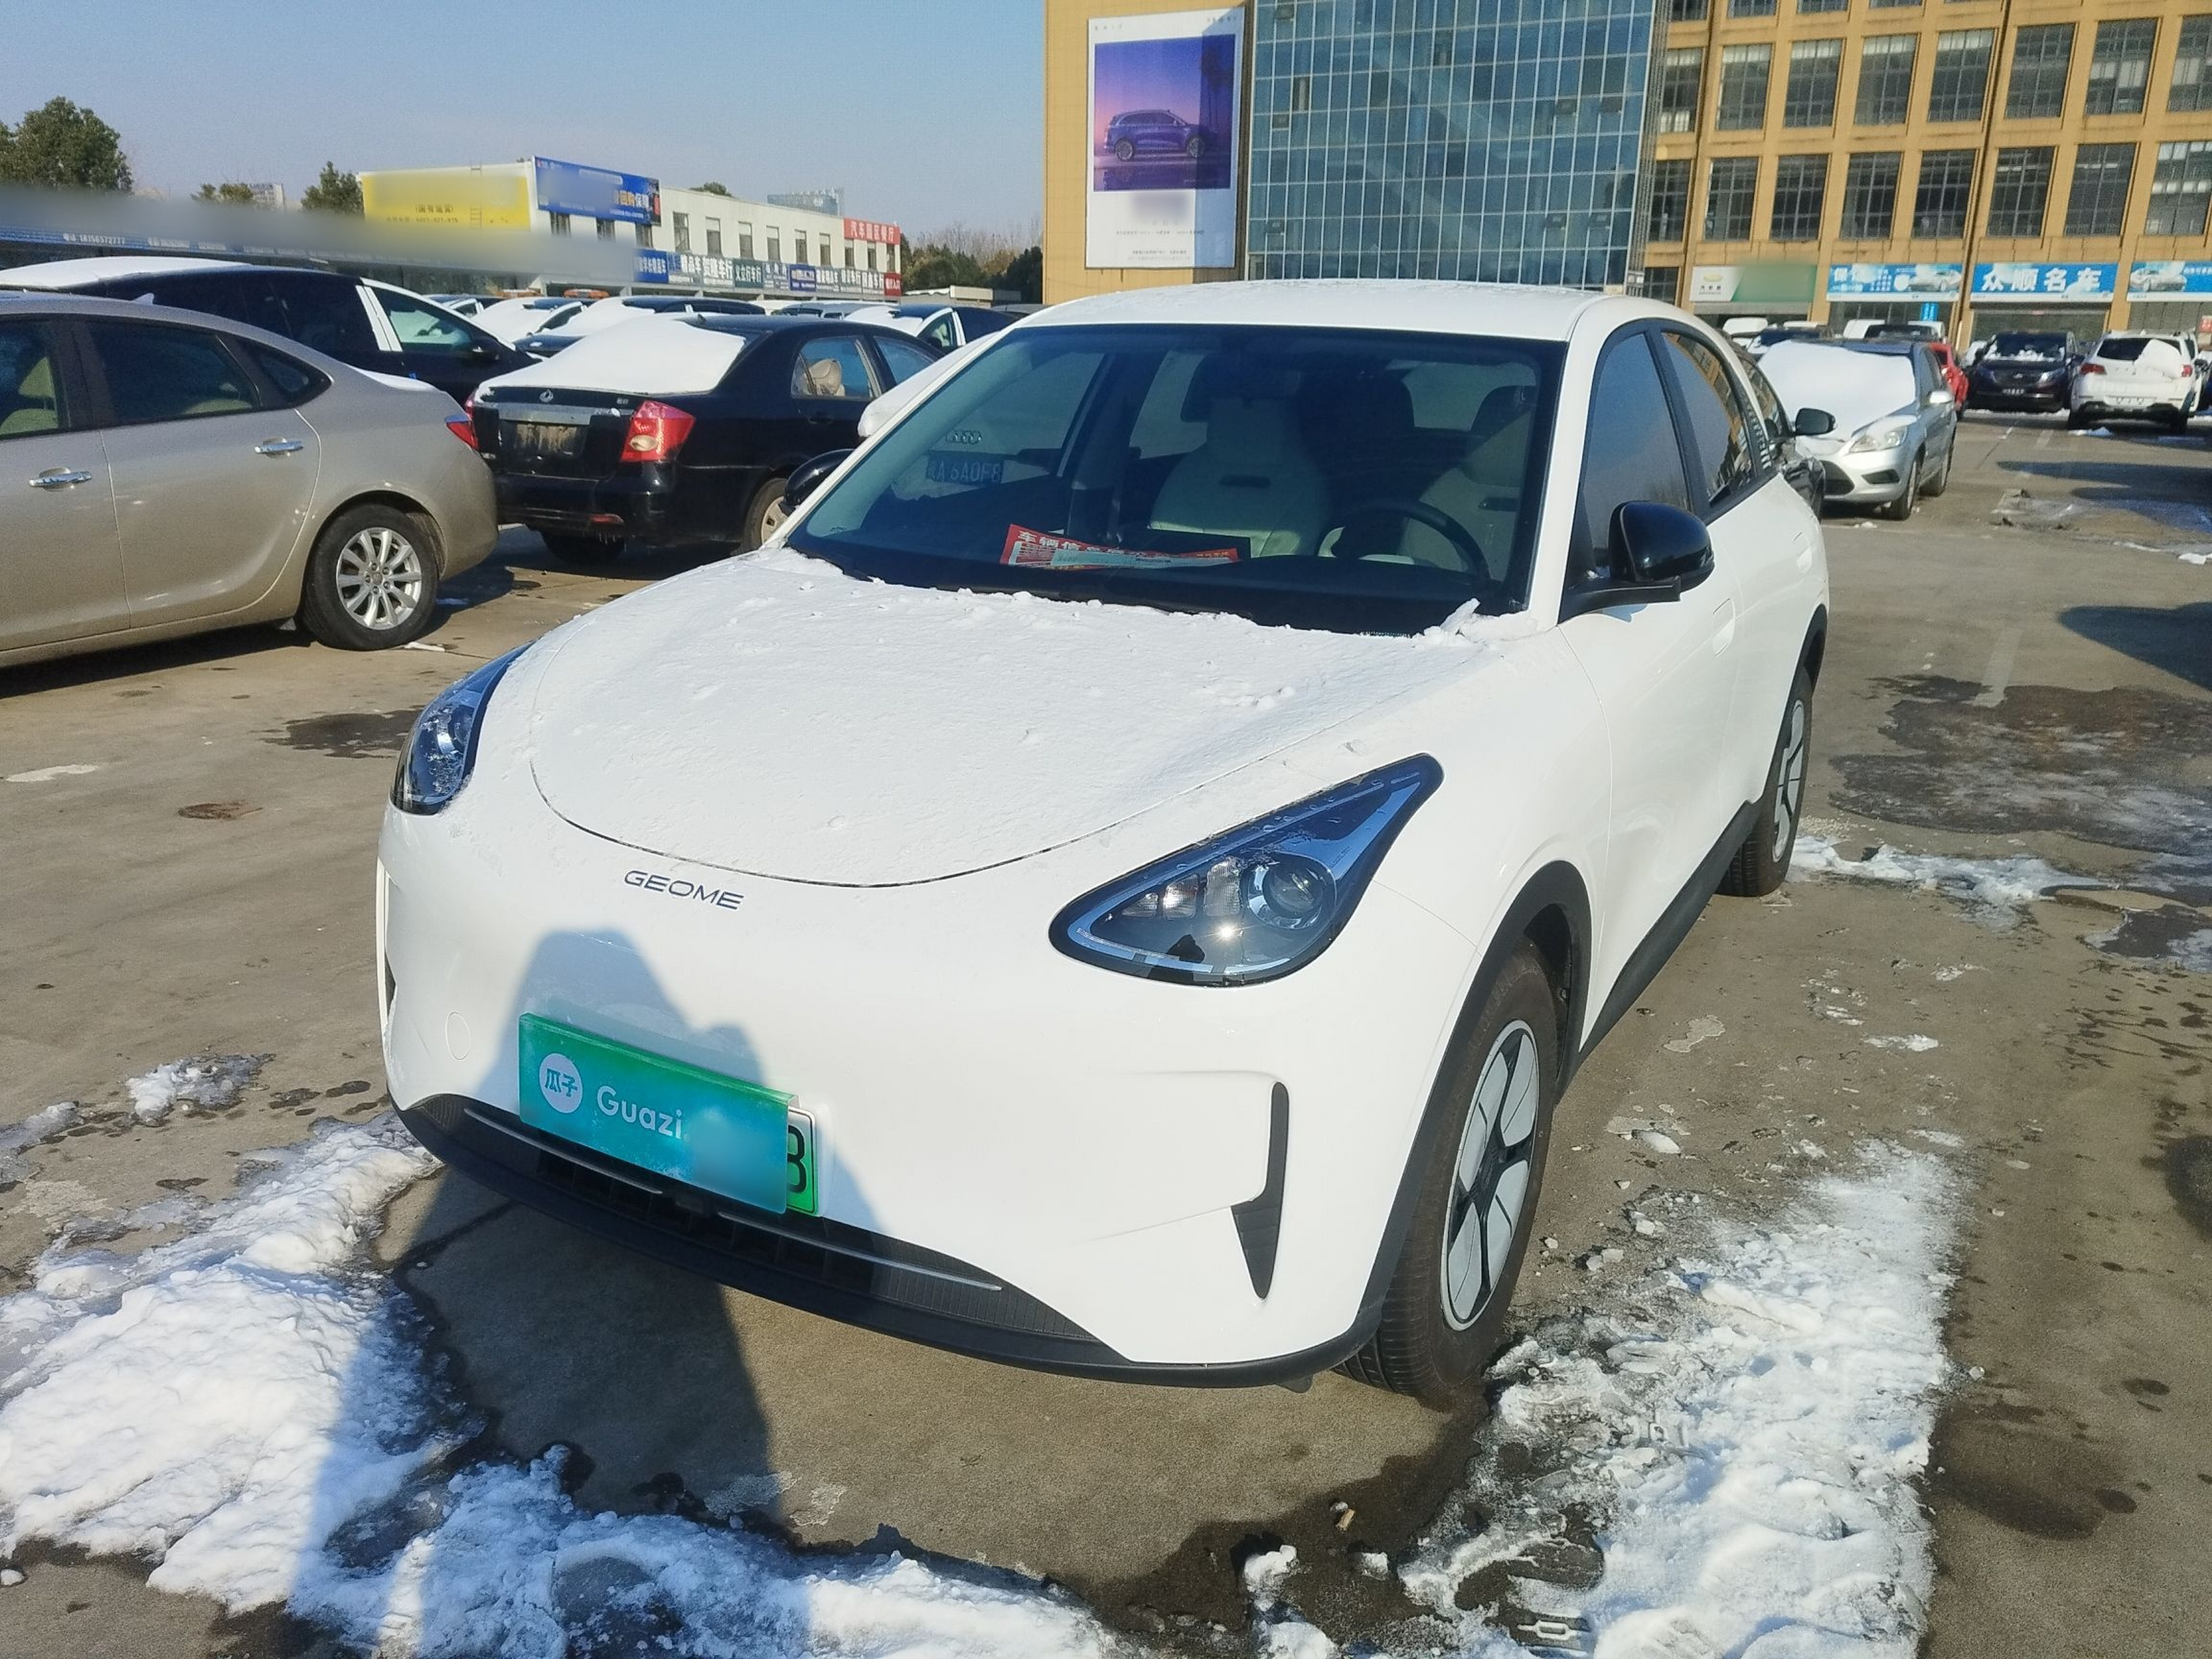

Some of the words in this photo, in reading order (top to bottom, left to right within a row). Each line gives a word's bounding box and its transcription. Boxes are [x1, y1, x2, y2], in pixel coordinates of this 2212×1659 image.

[1981, 267, 2103, 292] 众顺名车
[624, 870, 745, 910] GEOME
[544, 1067, 578, 1098] 瓜子
[597, 1085, 682, 1140] Guazi
